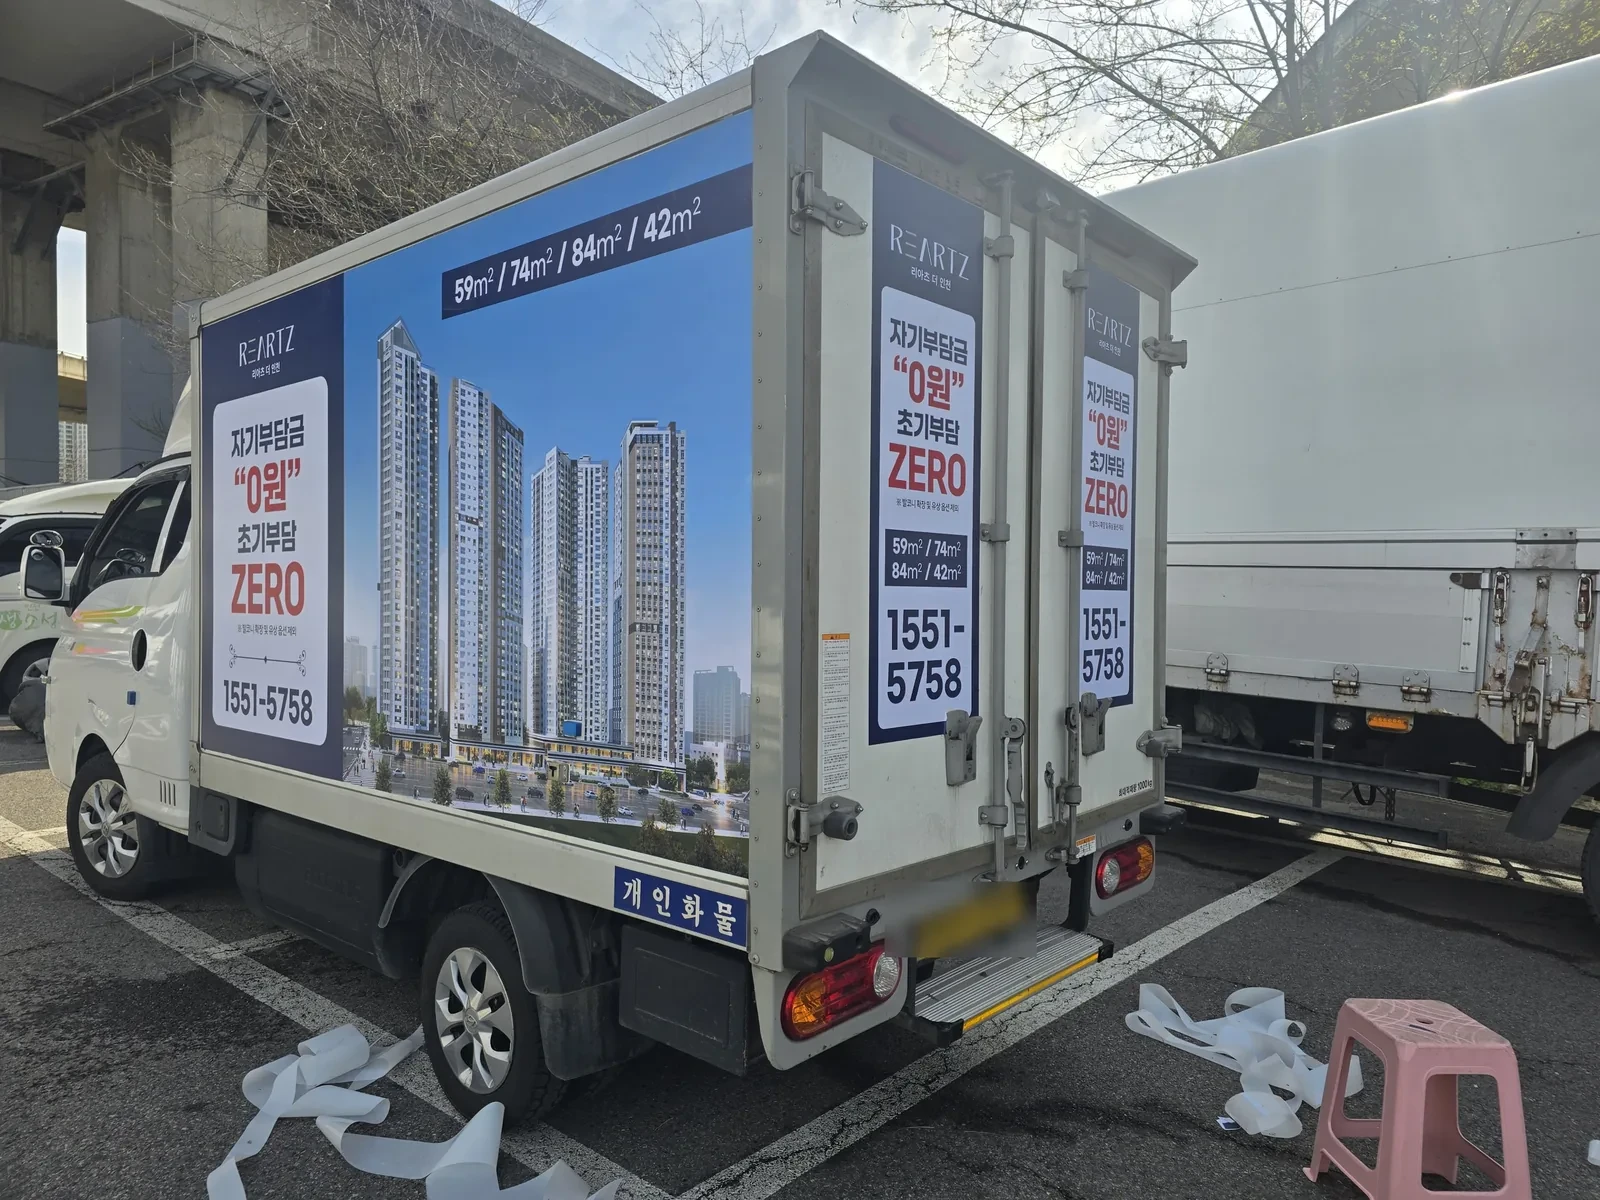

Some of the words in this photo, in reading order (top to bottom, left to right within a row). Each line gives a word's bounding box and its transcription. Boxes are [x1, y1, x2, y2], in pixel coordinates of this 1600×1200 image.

[889, 223, 971, 281] REARTZ
[931, 272, 939, 285] 더
[238, 324, 295, 367] REARTZ
[889, 317, 968, 366] 자기부담금
[1088, 307, 1132, 348] REARTZ
[893, 355, 964, 411] “0원”
[1086, 380, 1130, 415] 자기부담금
[231, 414, 305, 458] 자기부담금
[897, 408, 960, 446] 초기부담
[1088, 408, 1128, 451] “0원”
[234, 457, 301, 514] “0원”
[888, 442, 967, 497] ZERO
[1089, 450, 1125, 478] 초기부담
[1084, 476, 1128, 519] ZERO
[237, 519, 297, 554] 초기부담
[231, 561, 305, 616] ZERO
[887, 609, 965, 651] 1551-
[1083, 608, 1126, 641] 1551-
[887, 658, 962, 704] 5758
[1082, 646, 1124, 683] 5758
[223, 679, 313, 727] 1551-5758
